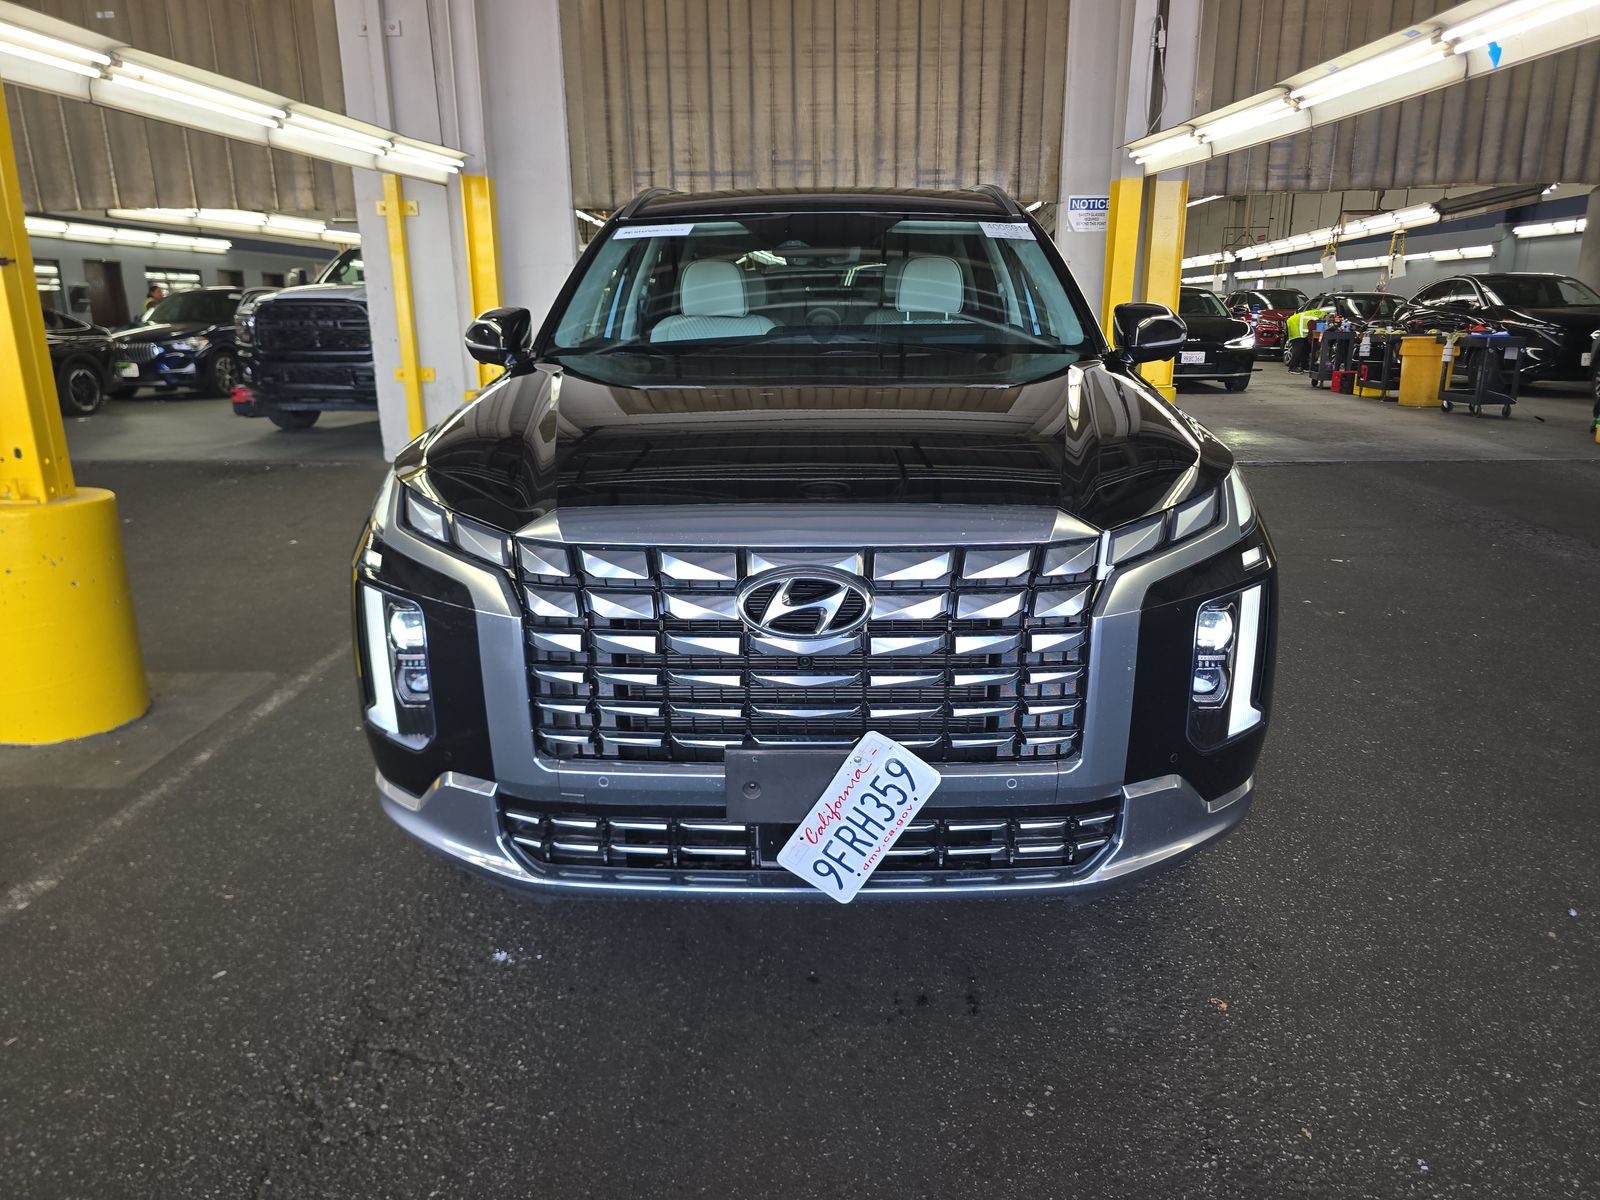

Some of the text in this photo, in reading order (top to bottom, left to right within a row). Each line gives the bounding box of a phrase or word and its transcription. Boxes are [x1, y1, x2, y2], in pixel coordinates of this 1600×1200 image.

[805, 763, 873, 845] California
[812, 757, 916, 890] 9FRH359
[863, 804, 913, 871] dmv.ca.gov
